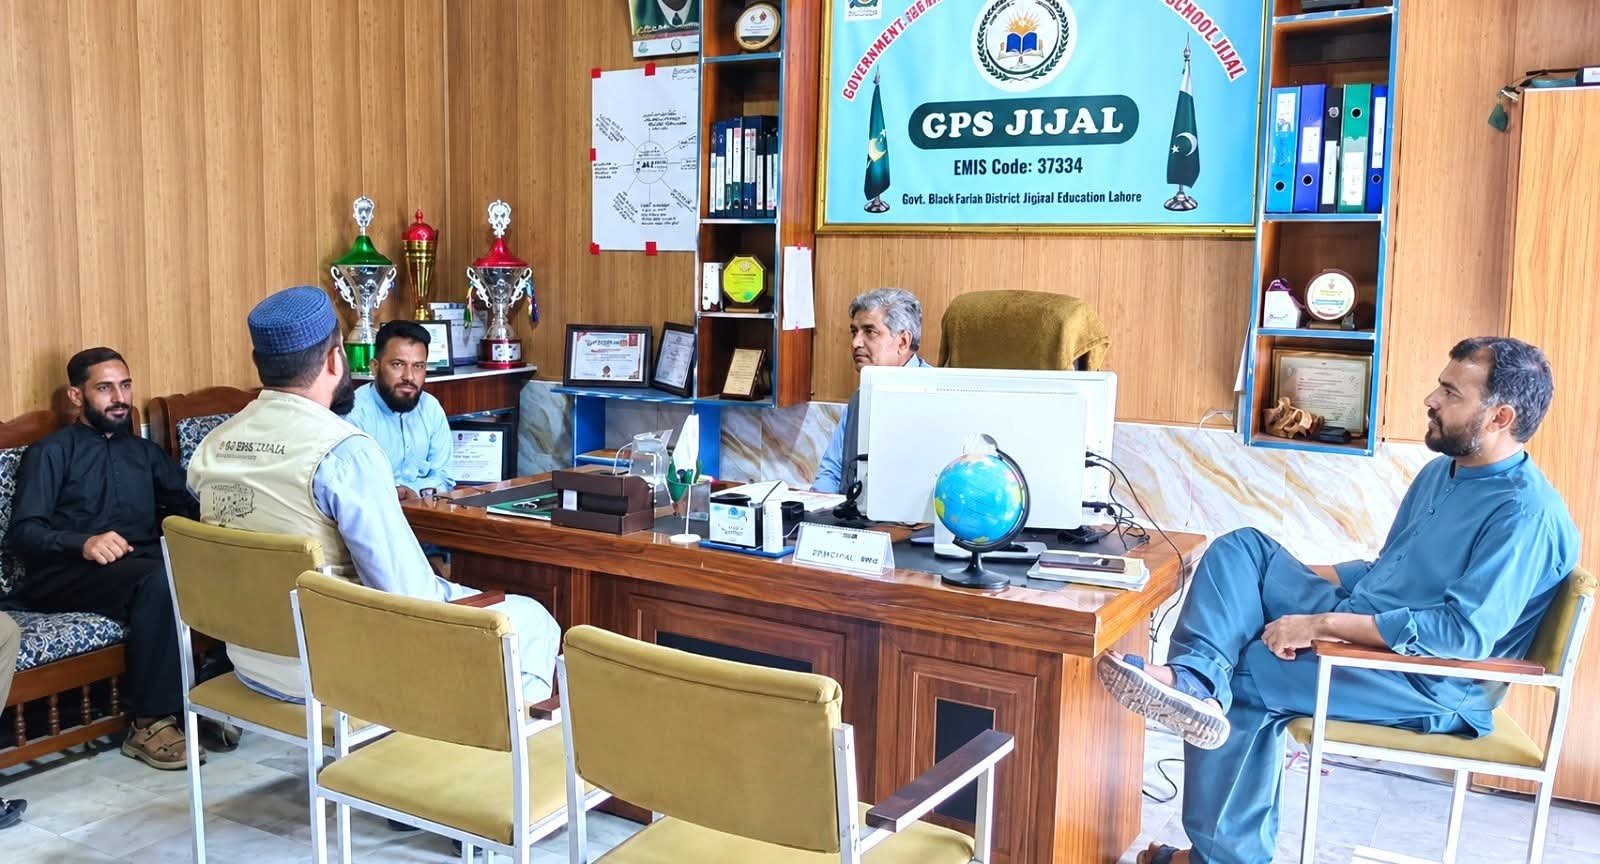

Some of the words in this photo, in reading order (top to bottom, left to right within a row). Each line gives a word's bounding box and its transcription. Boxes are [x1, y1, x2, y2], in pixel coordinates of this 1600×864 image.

[1211, 38, 1245, 80] JIJAL
[921, 110, 995, 139] GPS
[1004, 106, 1124, 136] JIJAL
[953, 159, 987, 176] EMIS
[991, 158, 1033, 175] Code:
[1037, 157, 1084, 174] 37334
[902, 193, 926, 205] Govt.
[928, 192, 954, 205] Black
[985, 192, 1020, 205] District
[1057, 190, 1106, 204] Education
[1108, 190, 1143, 203] Lahore
